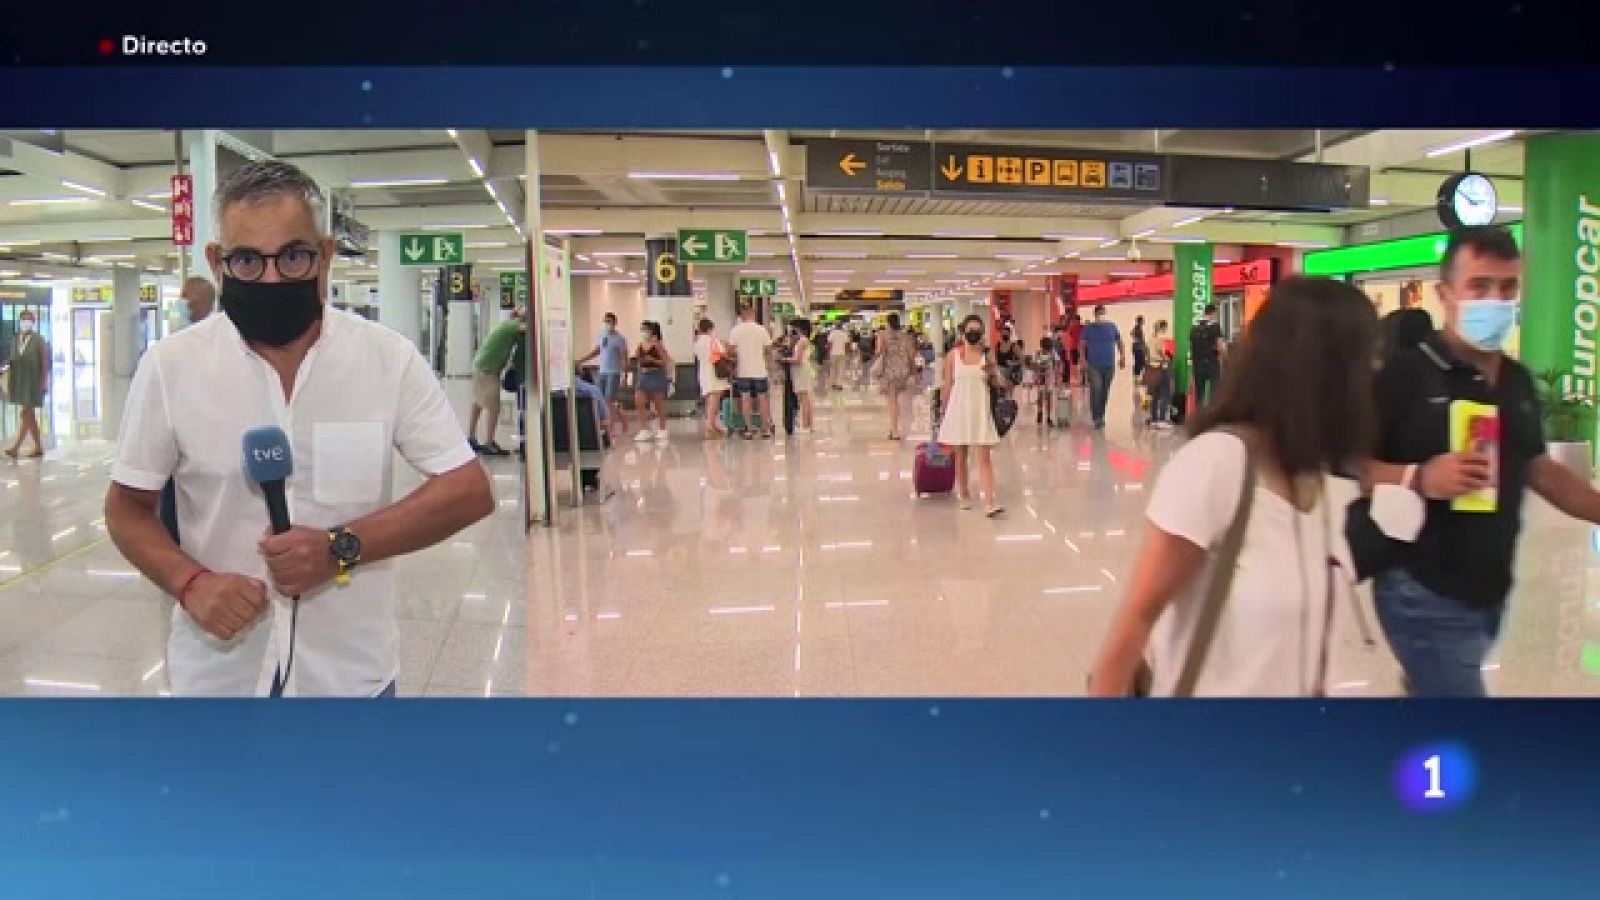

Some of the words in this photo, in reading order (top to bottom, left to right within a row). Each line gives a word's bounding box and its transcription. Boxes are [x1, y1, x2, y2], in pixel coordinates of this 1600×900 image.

[1030, 162, 1045, 181] P
[655, 252, 677, 284] 6
[449, 271, 464, 294] 3
[1561, 194, 1600, 407] Europcar
[253, 446, 284, 462] tve
